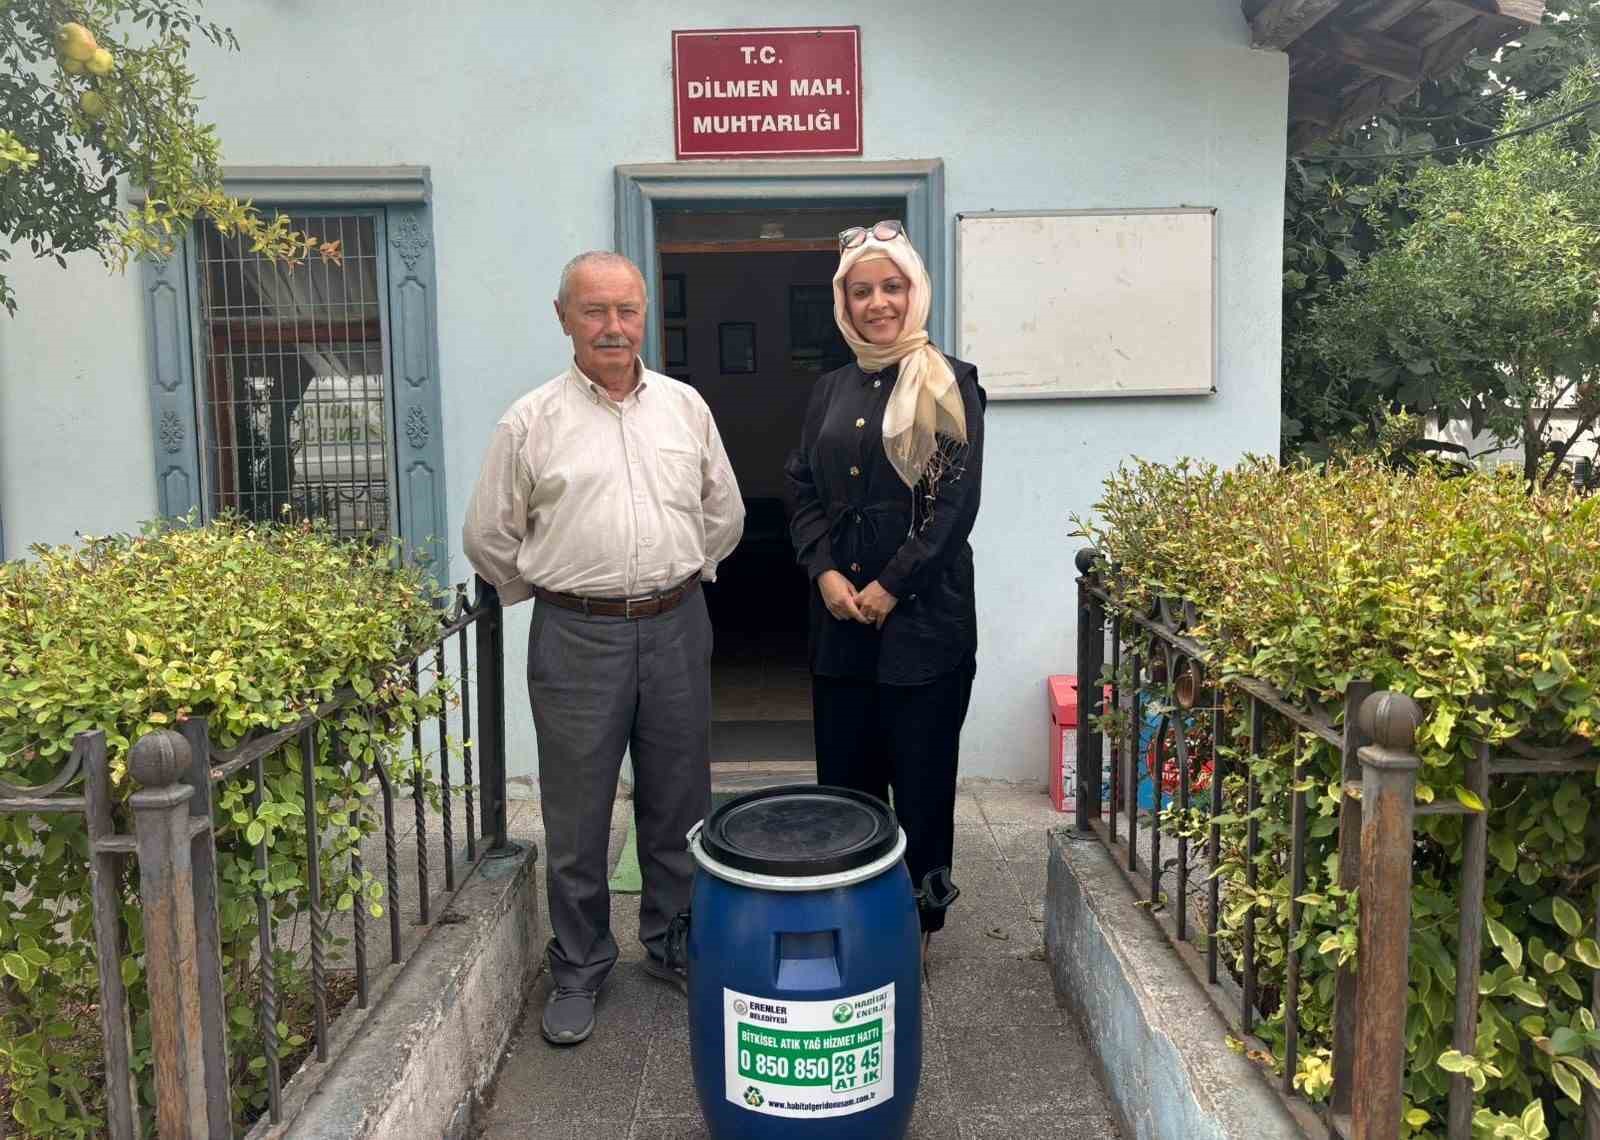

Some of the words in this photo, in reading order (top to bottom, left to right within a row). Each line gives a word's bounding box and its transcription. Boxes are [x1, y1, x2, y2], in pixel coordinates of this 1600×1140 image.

[740, 46, 783, 64] T.C.
[687, 76, 778, 98] DİLMEN
[790, 78, 850, 97] MAH.
[693, 108, 841, 134] MUHTARLIĞI
[749, 1001, 787, 1015] ERENLER
[749, 1011, 788, 1024] BELEDİYESİ
[741, 1029, 779, 1049] BİTKİSEL
[780, 1038, 801, 1049] ATIK
[803, 1037, 821, 1050] YAĞ
[823, 1034, 856, 1049] HİZMET
[857, 1027, 879, 1044] HATTI
[740, 1050, 751, 1071] 0
[756, 1053, 789, 1078] 850
[794, 1057, 829, 1079] 850
[834, 1053, 856, 1077] 28
[861, 1046, 880, 1070] 45
[835, 1076, 858, 1090] AT
[863, 1070, 880, 1084] IK
